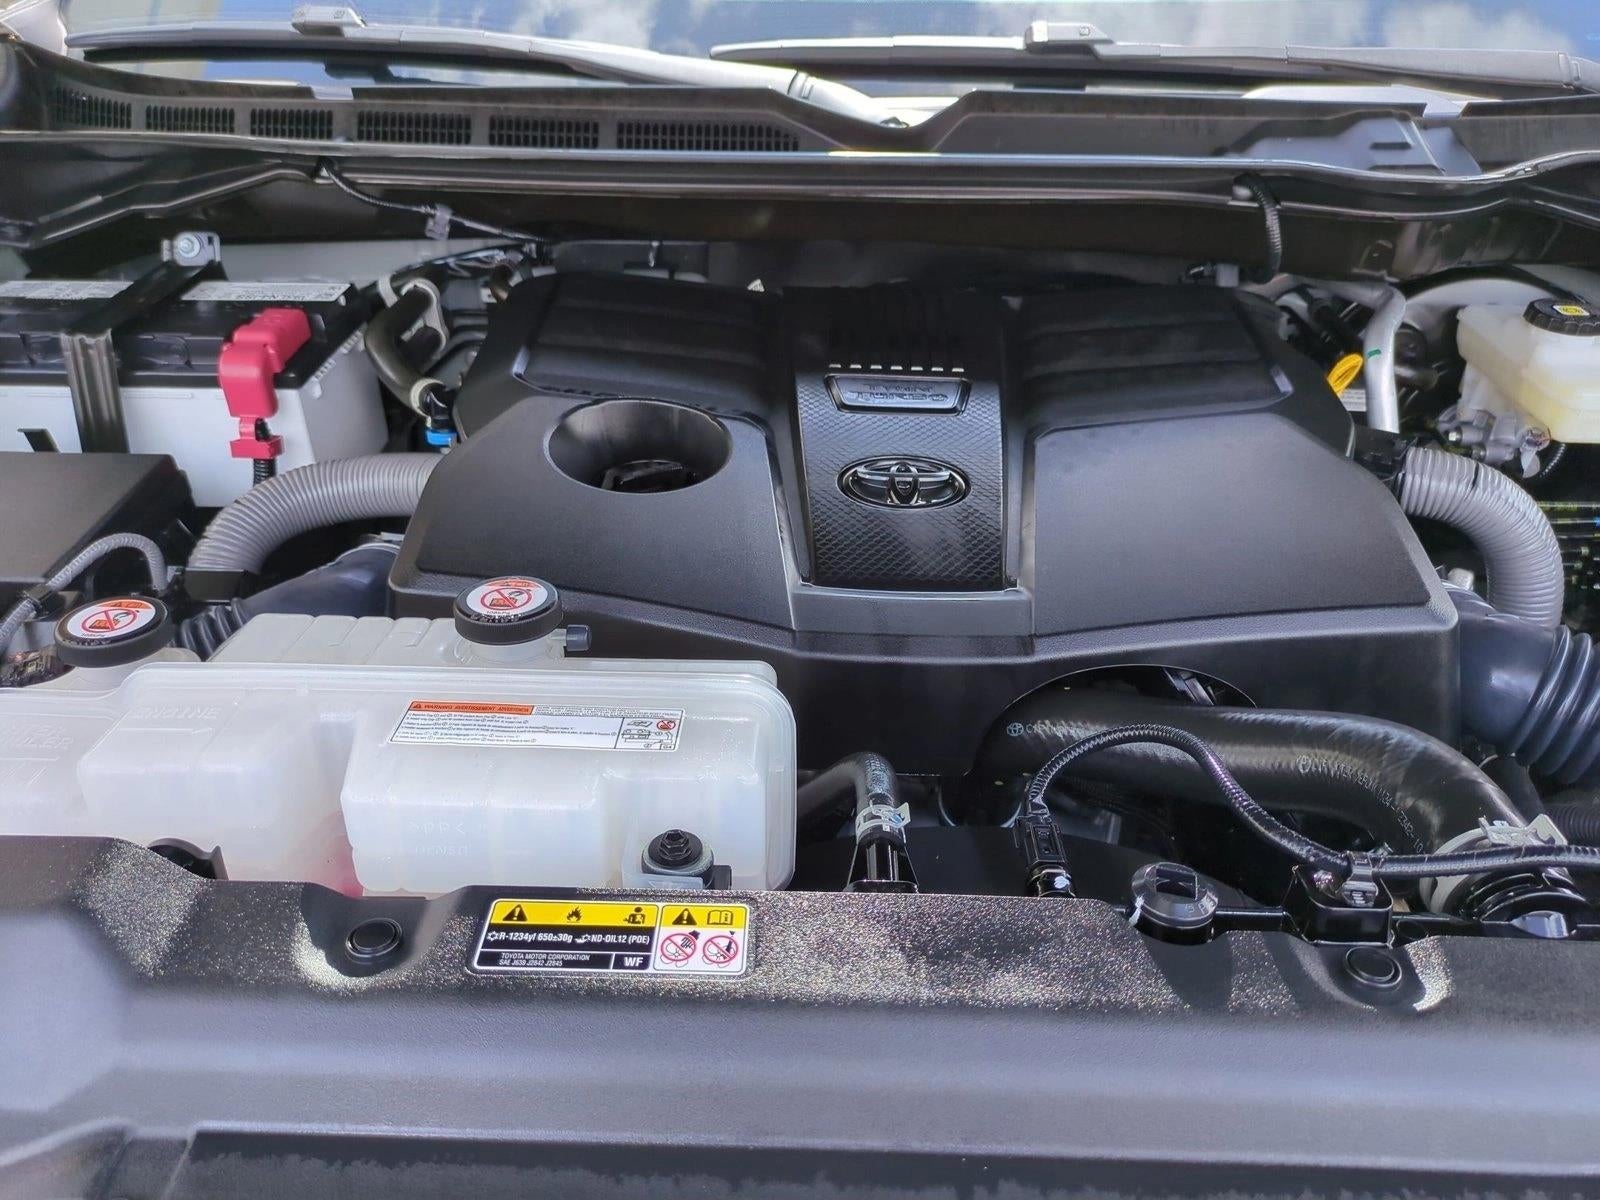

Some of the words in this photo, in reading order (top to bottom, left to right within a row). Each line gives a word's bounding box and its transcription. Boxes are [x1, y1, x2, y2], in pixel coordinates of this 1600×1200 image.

[499, 932, 536, 942] R-1234yf
[537, 932, 573, 943] 650±30g
[628, 934, 650, 944] (POE)
[548, 953, 590, 961] CORPORATION
[624, 957, 644, 967] WF
